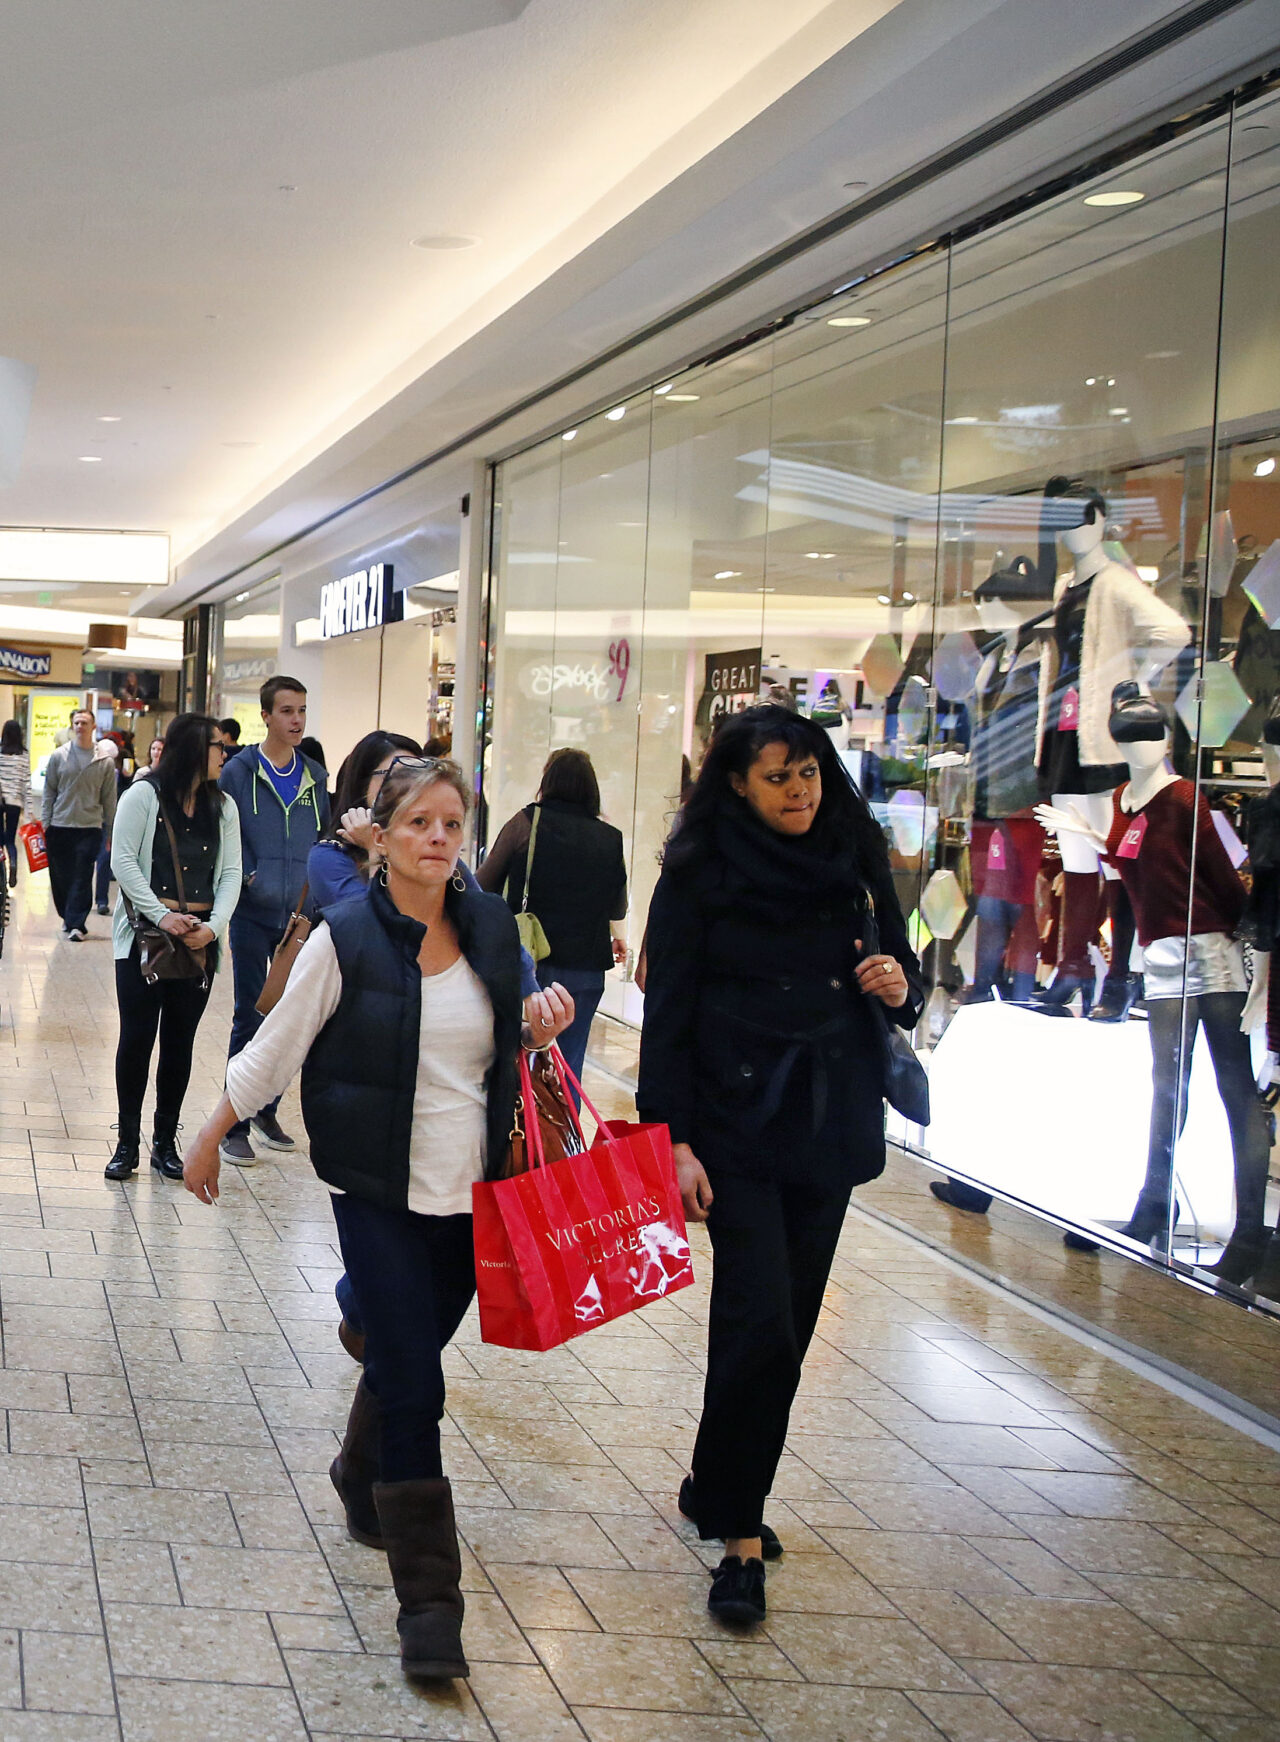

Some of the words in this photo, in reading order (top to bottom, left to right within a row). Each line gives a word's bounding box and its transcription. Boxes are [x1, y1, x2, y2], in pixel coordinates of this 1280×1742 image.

[367, 562, 385, 628] 21
[711, 665, 756, 691] GREAT
[546, 1195, 661, 1251] VICTORIA'S
